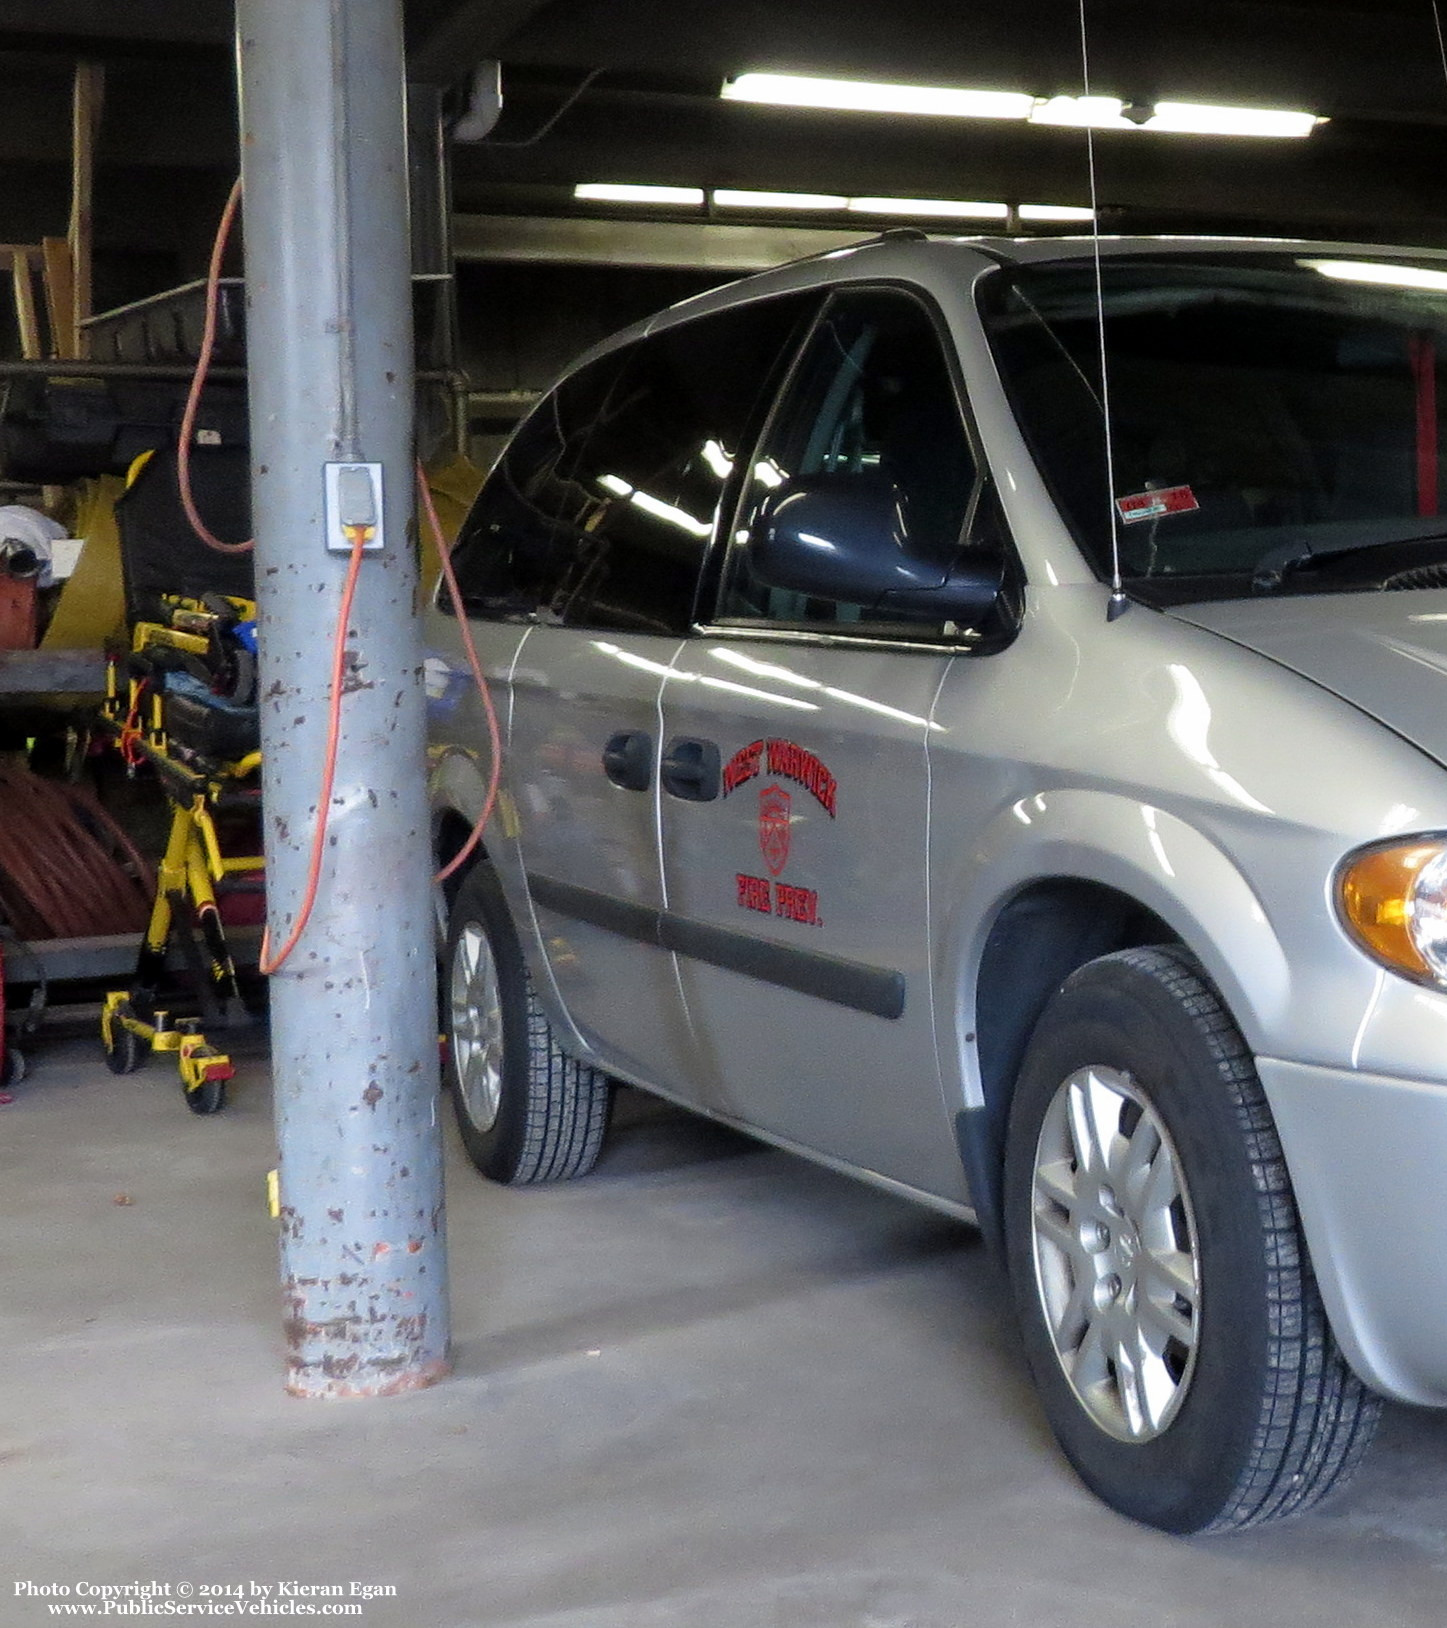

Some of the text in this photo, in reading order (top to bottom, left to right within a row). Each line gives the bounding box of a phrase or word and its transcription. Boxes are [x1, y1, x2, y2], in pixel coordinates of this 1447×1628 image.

[723, 737, 838, 819] WEST WARWICK
[735, 872, 772, 913] FIRE
